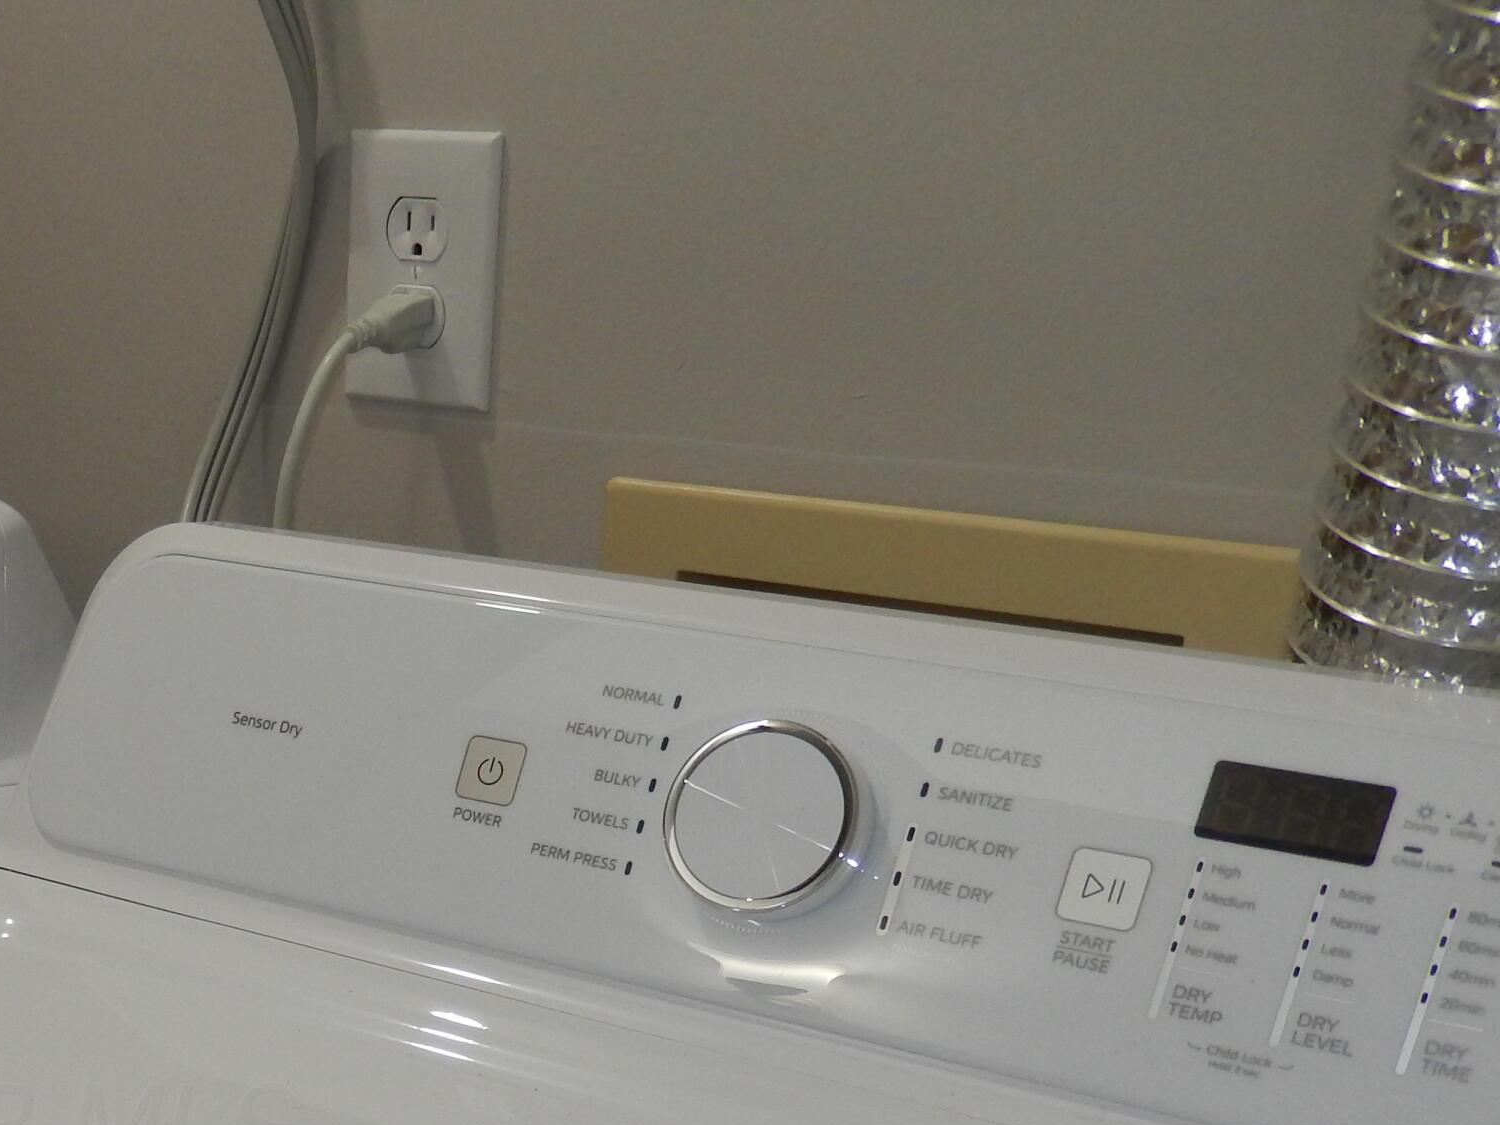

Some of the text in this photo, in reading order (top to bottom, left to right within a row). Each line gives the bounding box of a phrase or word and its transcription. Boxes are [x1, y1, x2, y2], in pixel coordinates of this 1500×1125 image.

[602, 685, 665, 707] NORMAL
[232, 711, 304, 740] Sensor Dry
[565, 721, 655, 748] HEAVY DUTY
[951, 742, 1043, 769] DELICATES
[593, 769, 642, 789] BULKY
[937, 786, 1015, 812] SANITIZE
[452, 807, 503, 828] POWER
[572, 807, 630, 831] TOWELS
[924, 830, 1020, 860] QUICK DRY
[530, 842, 618, 872] PERM PRESS
[1211, 864, 1243, 881] High
[912, 875, 994, 904] TIME DRY
[1338, 888, 1377, 906] More
[1202, 891, 1256, 911] Medium
[896, 919, 983, 949] AIR FLUFF
[1193, 918, 1222, 933] Low
[1330, 915, 1381, 936] Normal
[1059, 931, 1117, 953] START
[1320, 943, 1353, 961] Less
[1052, 950, 1112, 974] PAUSE
[1185, 944, 1239, 966] No Heat
[1312, 968, 1355, 988] Damp
[1449, 969, 1496, 988] 40min
[1171, 983, 1213, 1004] DRY
[1168, 1001, 1223, 1025] TEMP
[1296, 1011, 1341, 1033] DRY
[1290, 1030, 1353, 1059] LEVEL
[1424, 1038, 1469, 1061] DRY
[1206, 1043, 1273, 1069] Child Lock
[1421, 1057, 1474, 1084] TIME
